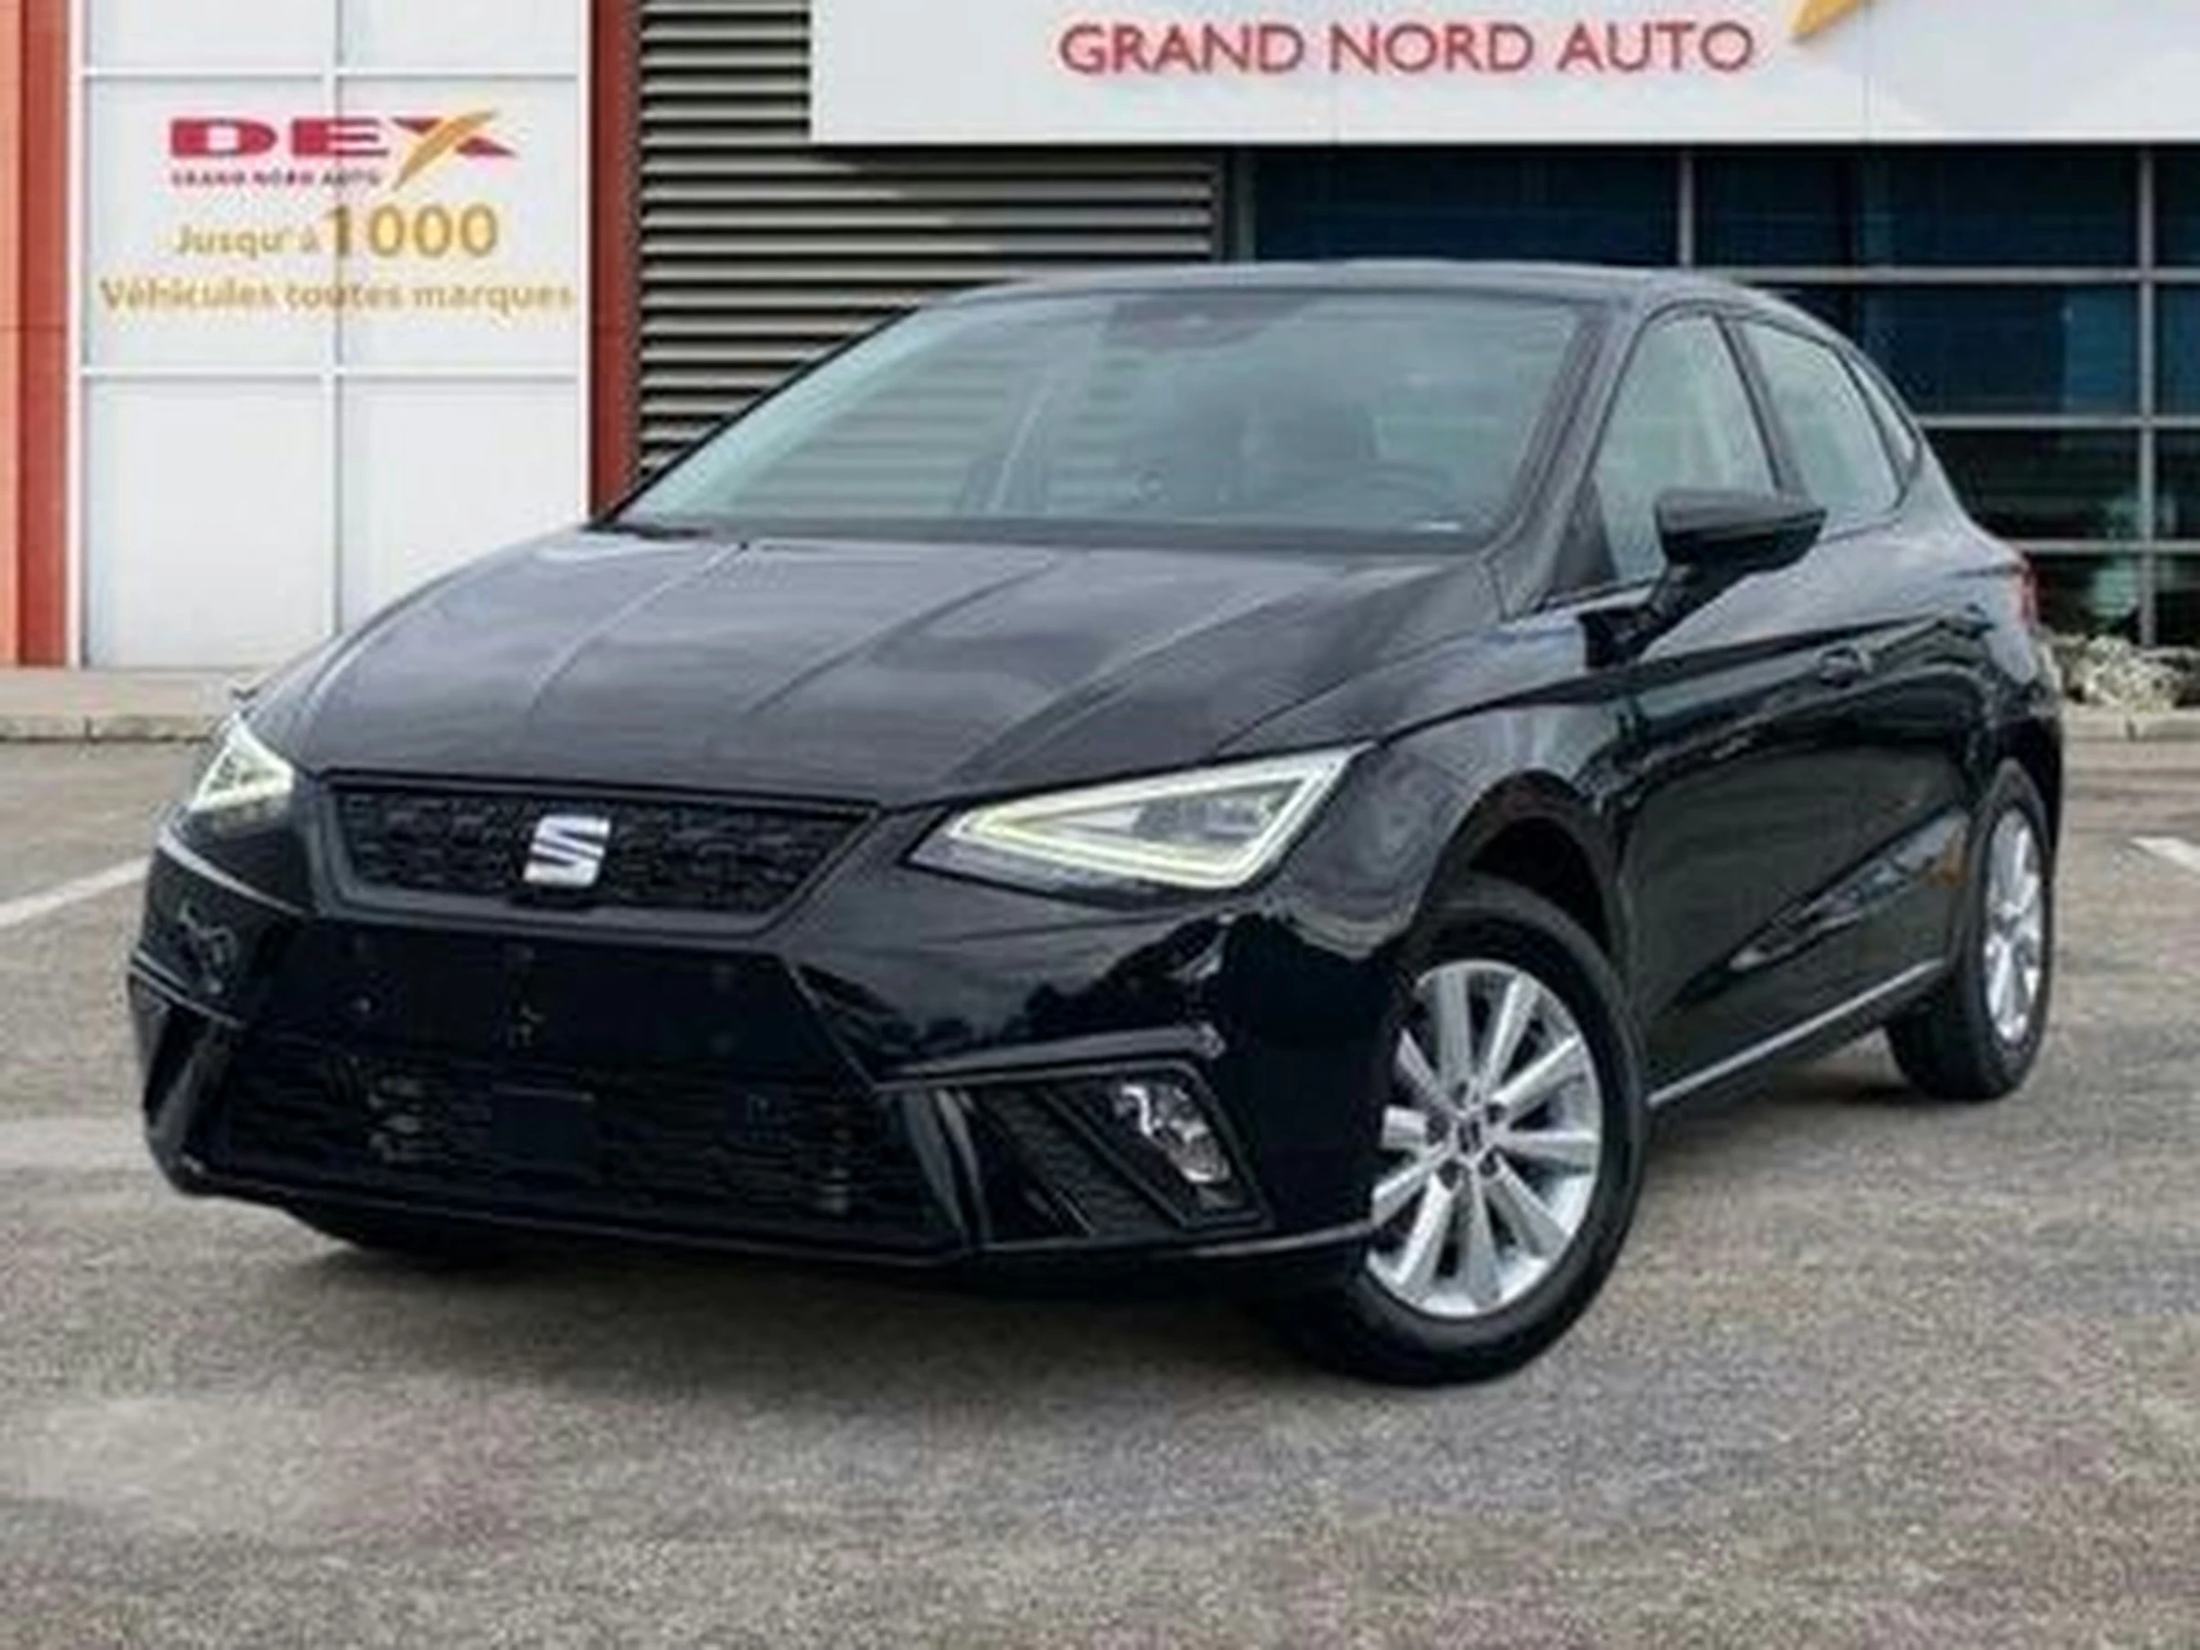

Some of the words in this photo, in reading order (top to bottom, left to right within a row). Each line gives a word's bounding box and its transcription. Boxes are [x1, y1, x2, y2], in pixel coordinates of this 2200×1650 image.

[1059, 22, 1305, 75] GRAND
[1329, 22, 1535, 74] NORD
[1556, 21, 1756, 73] AUTO
[169, 113, 516, 176] DEX
[322, 201, 500, 258] 1000
[284, 282, 403, 311] toutes
[412, 284, 575, 317] marques
